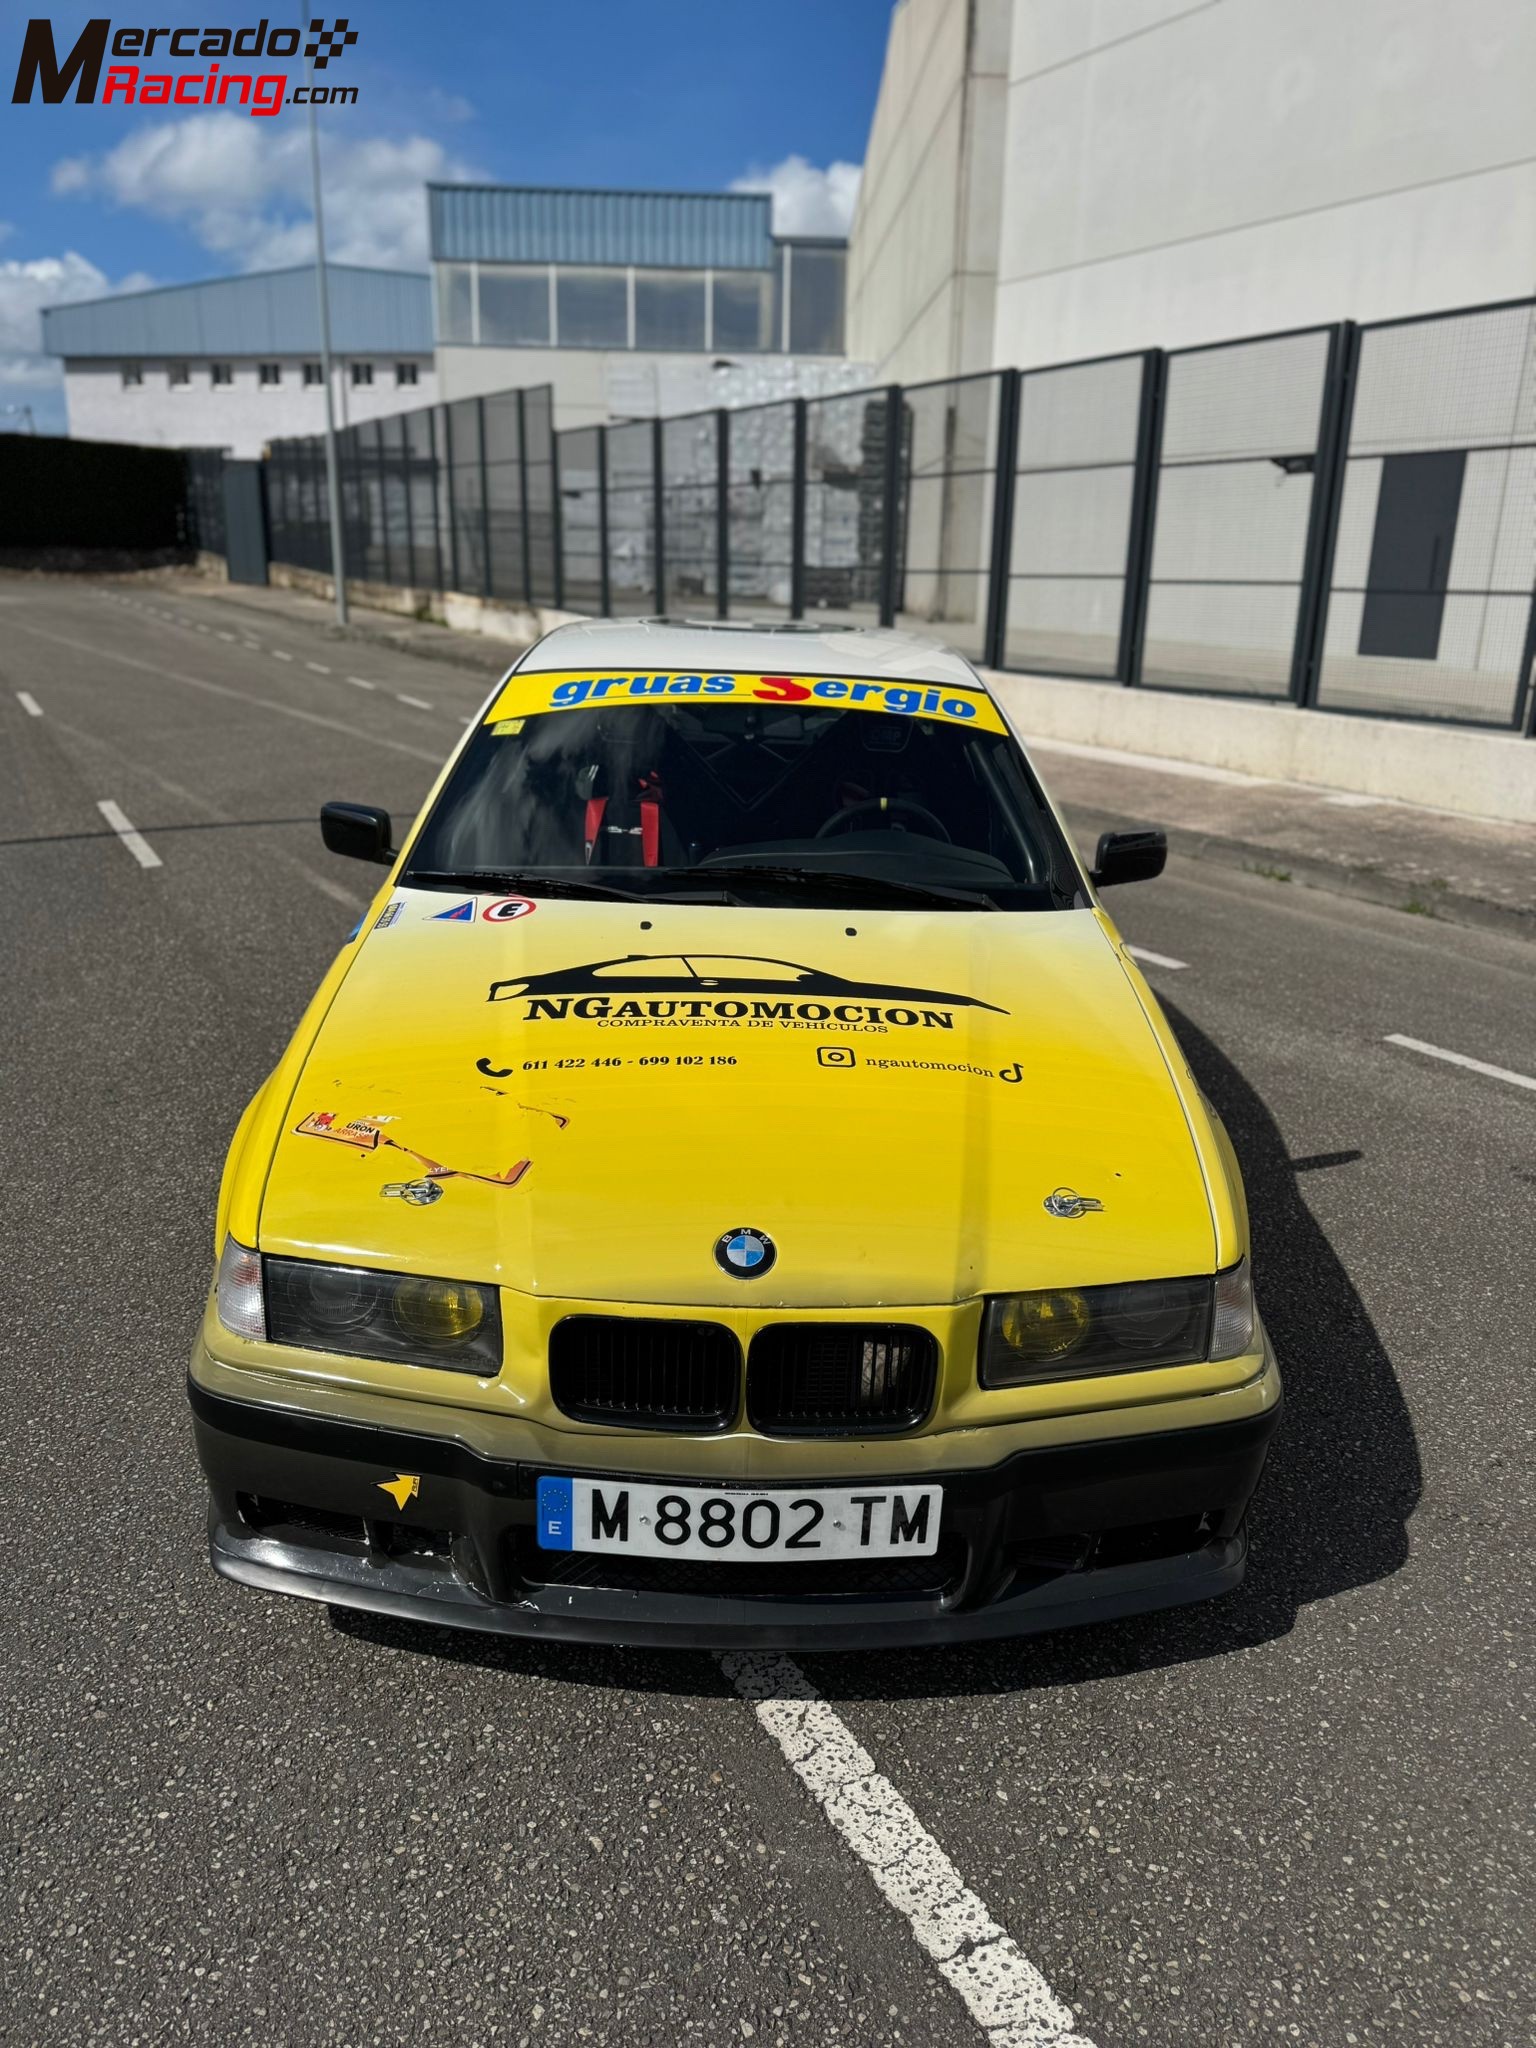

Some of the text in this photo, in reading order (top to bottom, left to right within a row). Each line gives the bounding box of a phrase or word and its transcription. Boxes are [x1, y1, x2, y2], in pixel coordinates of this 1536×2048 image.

[549, 676, 976, 718] gruas Sergio
[497, 903, 523, 917] E
[523, 997, 953, 1028] NGAUTOMOCION
[597, 1019, 741, 1028] COMPRAVENTA
[747, 1020, 774, 1028] DE
[522, 1060, 548, 1071] 611
[554, 1058, 586, 1069] 422
[591, 1057, 622, 1068] 446
[638, 1056, 670, 1067] 699
[675, 1056, 704, 1066] 102
[709, 1056, 738, 1066] 186
[865, 1058, 994, 1078] ngautomocion
[721, 1229, 771, 1244] BMW
[592, 1488, 931, 1550] M 8802 TM
[548, 1520, 562, 1535] E
